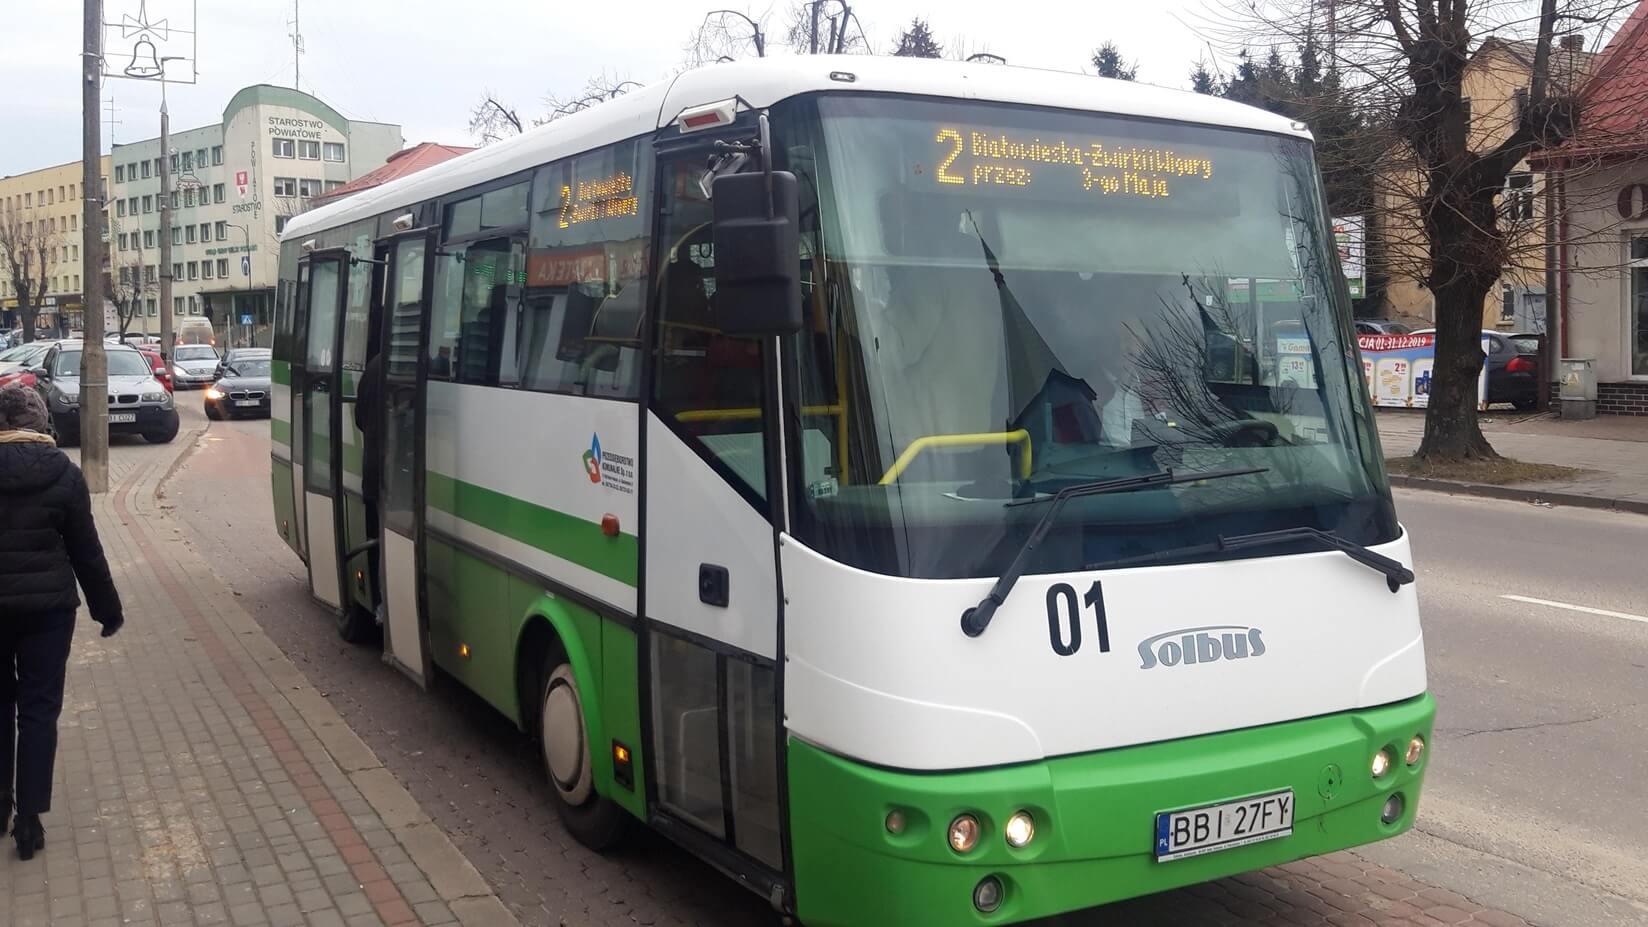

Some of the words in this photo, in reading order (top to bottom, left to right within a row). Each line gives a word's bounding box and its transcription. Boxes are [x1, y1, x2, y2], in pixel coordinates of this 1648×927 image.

[268, 117, 323, 129] STAROSTWO
[268, 127, 322, 140] POWIATOWE
[936, 129, 965, 184] 2
[972, 165, 1031, 185] przez:
[1124, 171, 1169, 198] Maja
[232, 201, 262, 215] STAROSTWO
[559, 185, 571, 229] 2
[1045, 580, 1111, 657] 01
[1137, 625, 1267, 670] Solbus
[1173, 810, 1223, 847] BBI
[1233, 796, 1290, 835] 27FY
[1159, 838, 1169, 847] PL
